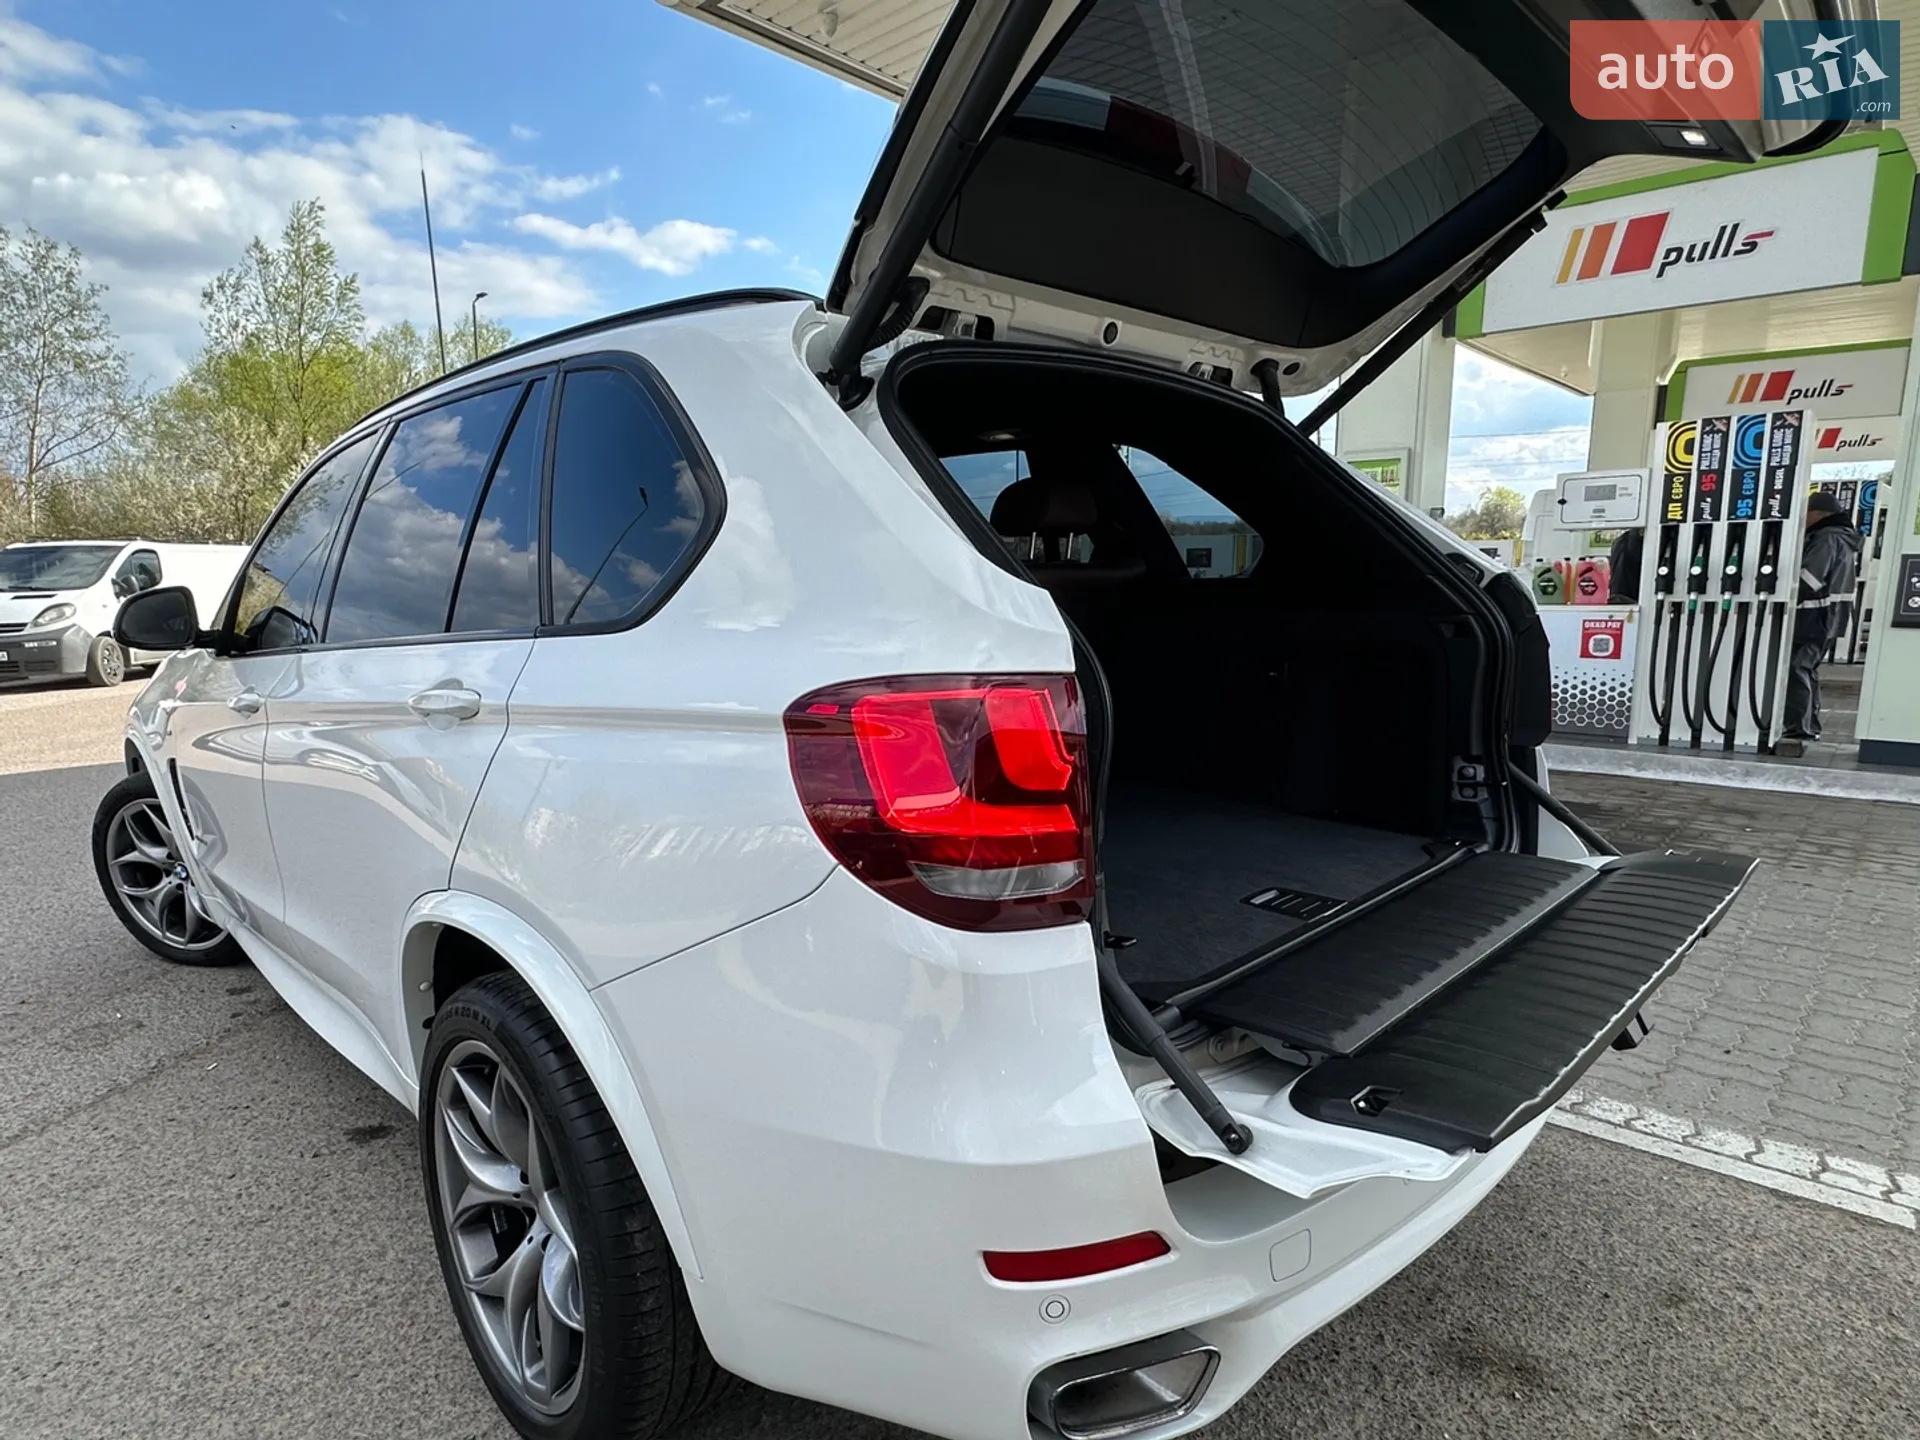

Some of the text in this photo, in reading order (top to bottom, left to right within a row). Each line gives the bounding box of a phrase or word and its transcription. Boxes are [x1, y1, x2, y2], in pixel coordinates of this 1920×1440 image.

[1656, 222, 1775, 279] pulls
[1786, 378, 1854, 405] pulls
[1835, 433, 1884, 452] pulls
[1700, 472, 1717, 492] 95
[1736, 499, 1754, 518] 95
